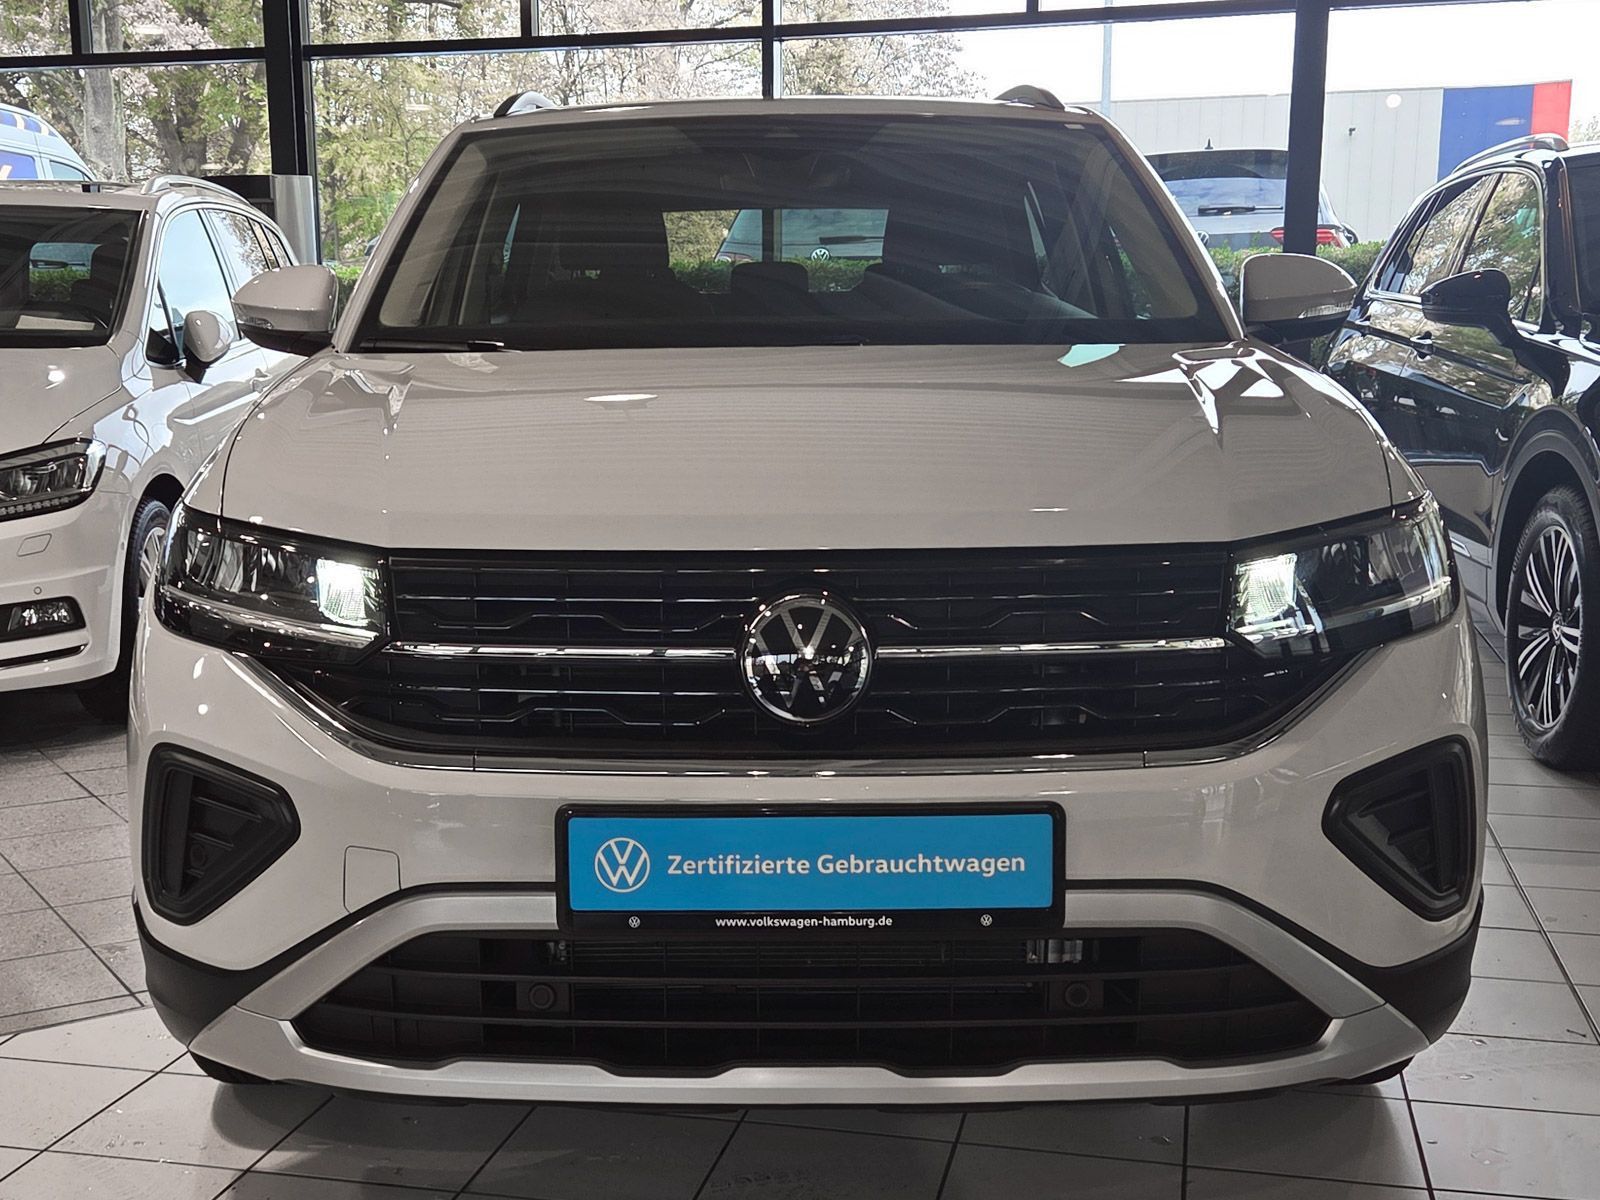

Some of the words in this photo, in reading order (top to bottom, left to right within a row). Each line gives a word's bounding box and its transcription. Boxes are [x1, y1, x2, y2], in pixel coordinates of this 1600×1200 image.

[667, 854, 810, 875] Zertifizierte
[817, 851, 1025, 878] Gebrauchtwagen
[714, 914, 894, 929] www.volkswagen-hamburg.de
